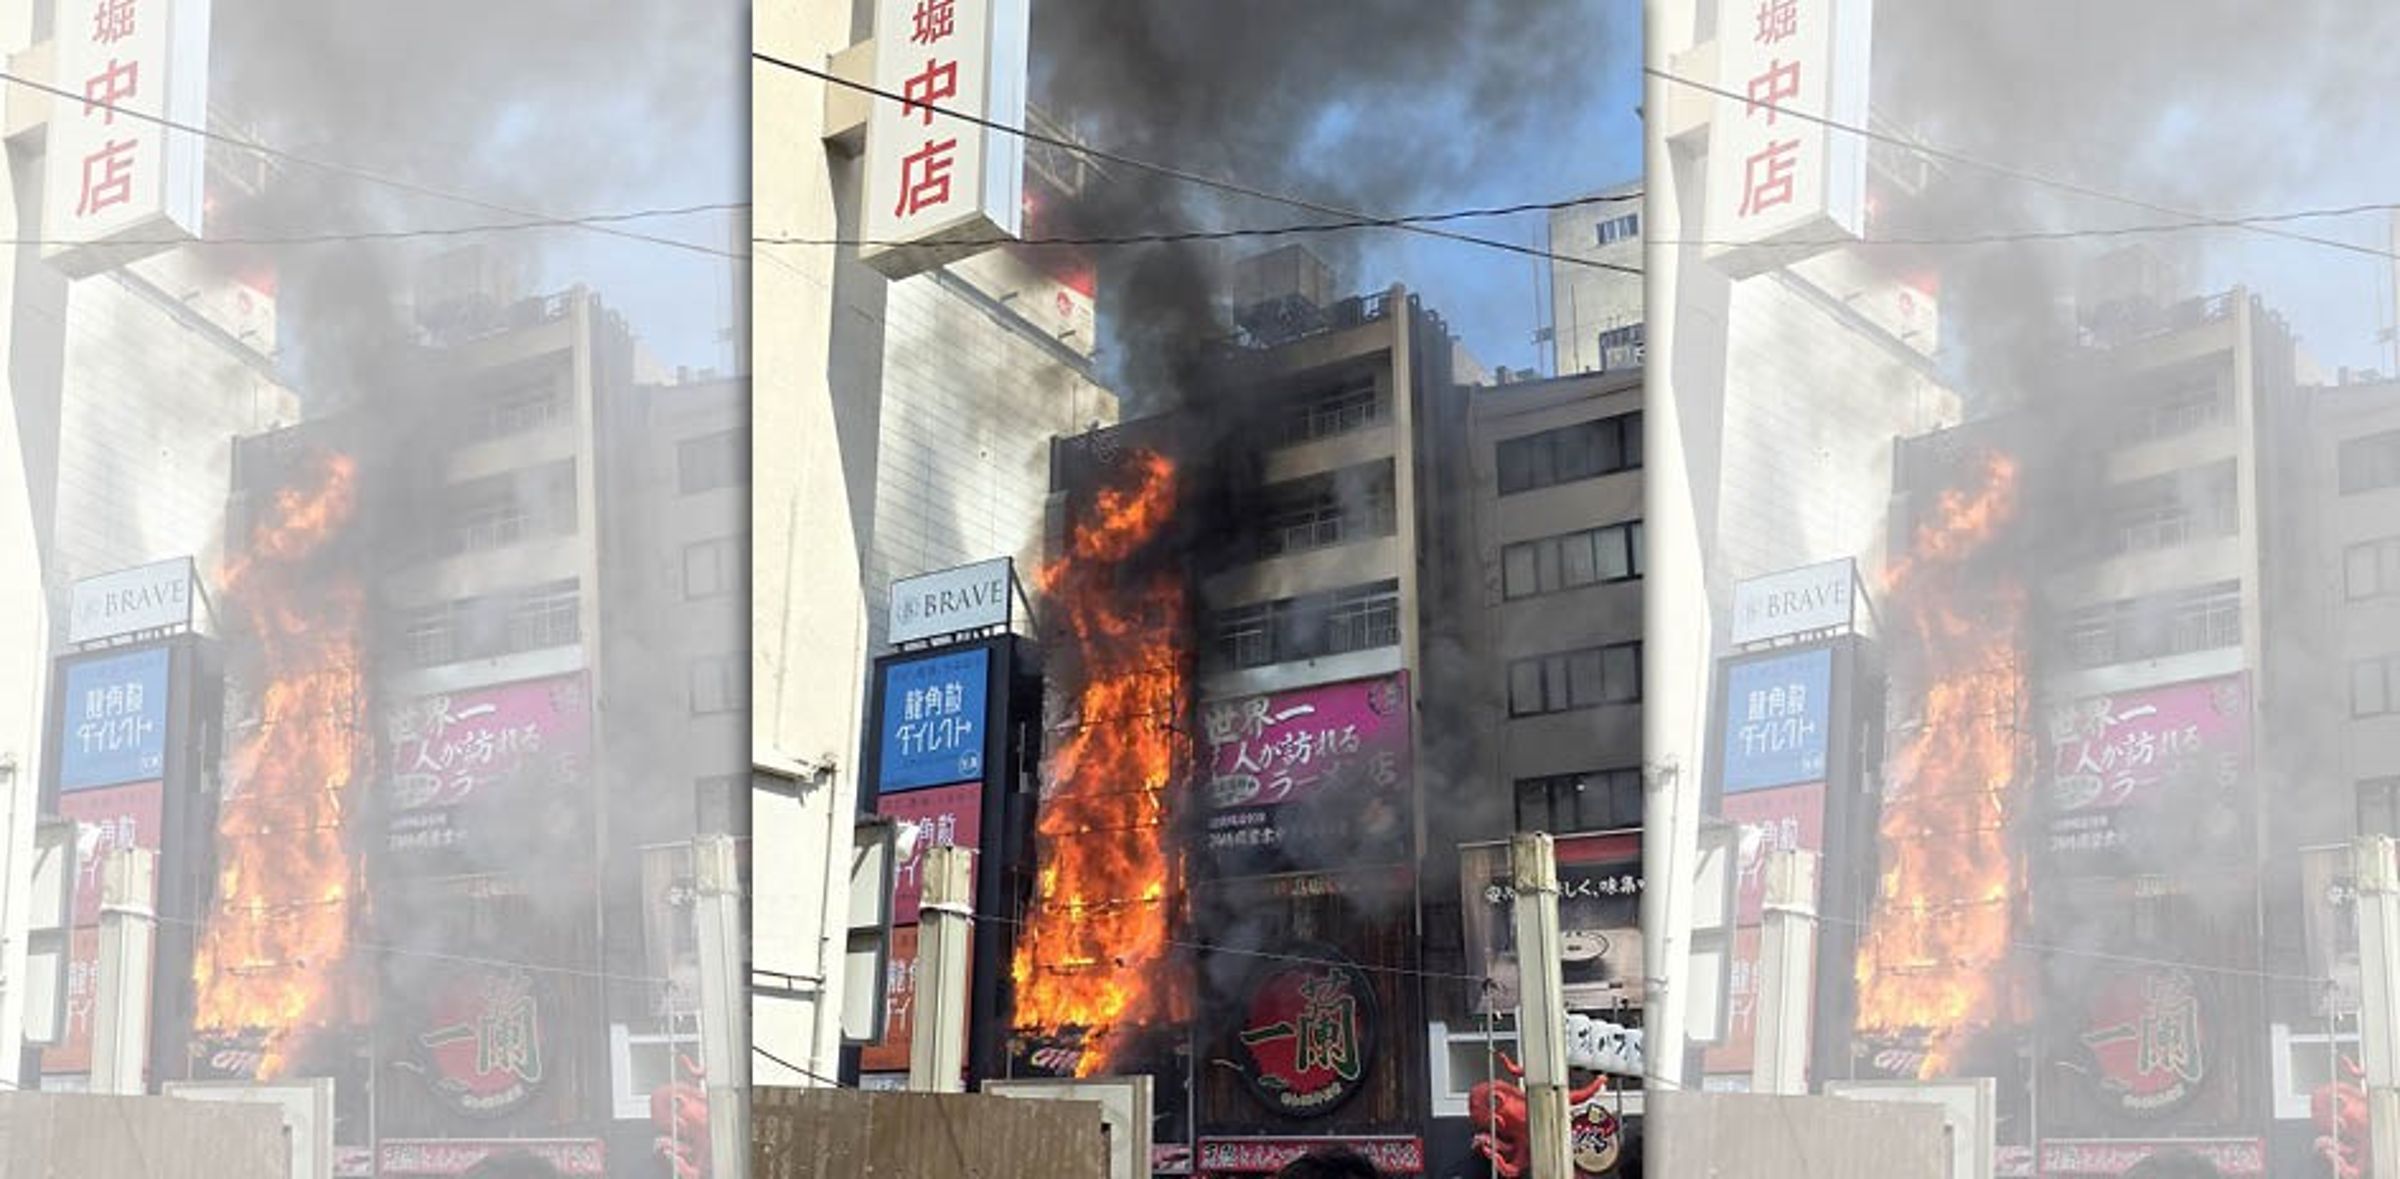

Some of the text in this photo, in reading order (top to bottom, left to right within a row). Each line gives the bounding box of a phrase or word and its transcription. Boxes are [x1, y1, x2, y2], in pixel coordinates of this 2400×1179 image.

[104, 577, 184, 618] BRAVE
[923, 578, 1003, 619] BRAVE
[1766, 578, 1846, 619] BRAVE
[1205, 697, 1316, 743] 世界一
[1240, 967, 1361, 1081] 一蘭
